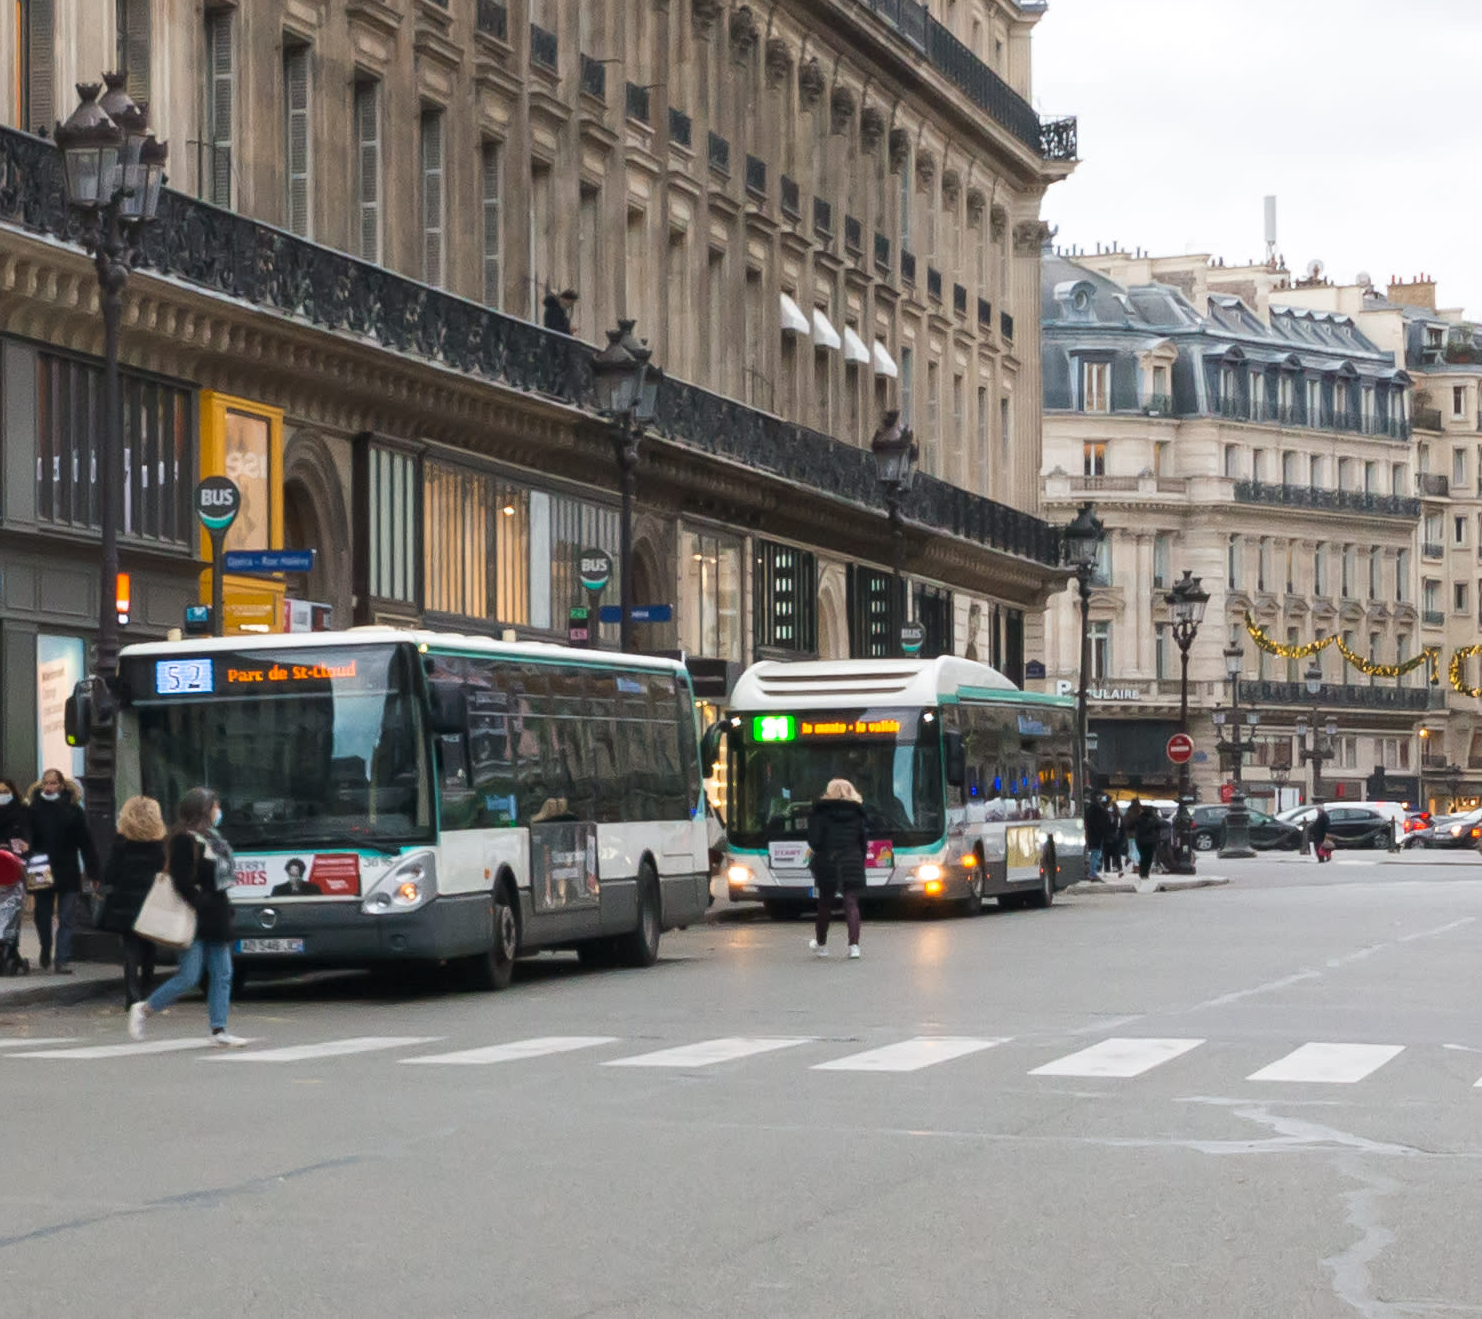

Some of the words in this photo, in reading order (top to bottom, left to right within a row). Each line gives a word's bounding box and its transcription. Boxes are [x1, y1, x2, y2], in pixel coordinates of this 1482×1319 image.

[201, 489, 234, 506] BUS
[580, 558, 607, 572] BUS
[901, 628, 922, 639] BUS
[168, 665, 201, 690] 52
[227, 668, 264, 682] Parc
[268, 665, 288, 680] de
[293, 659, 356, 679] St-Cloud
